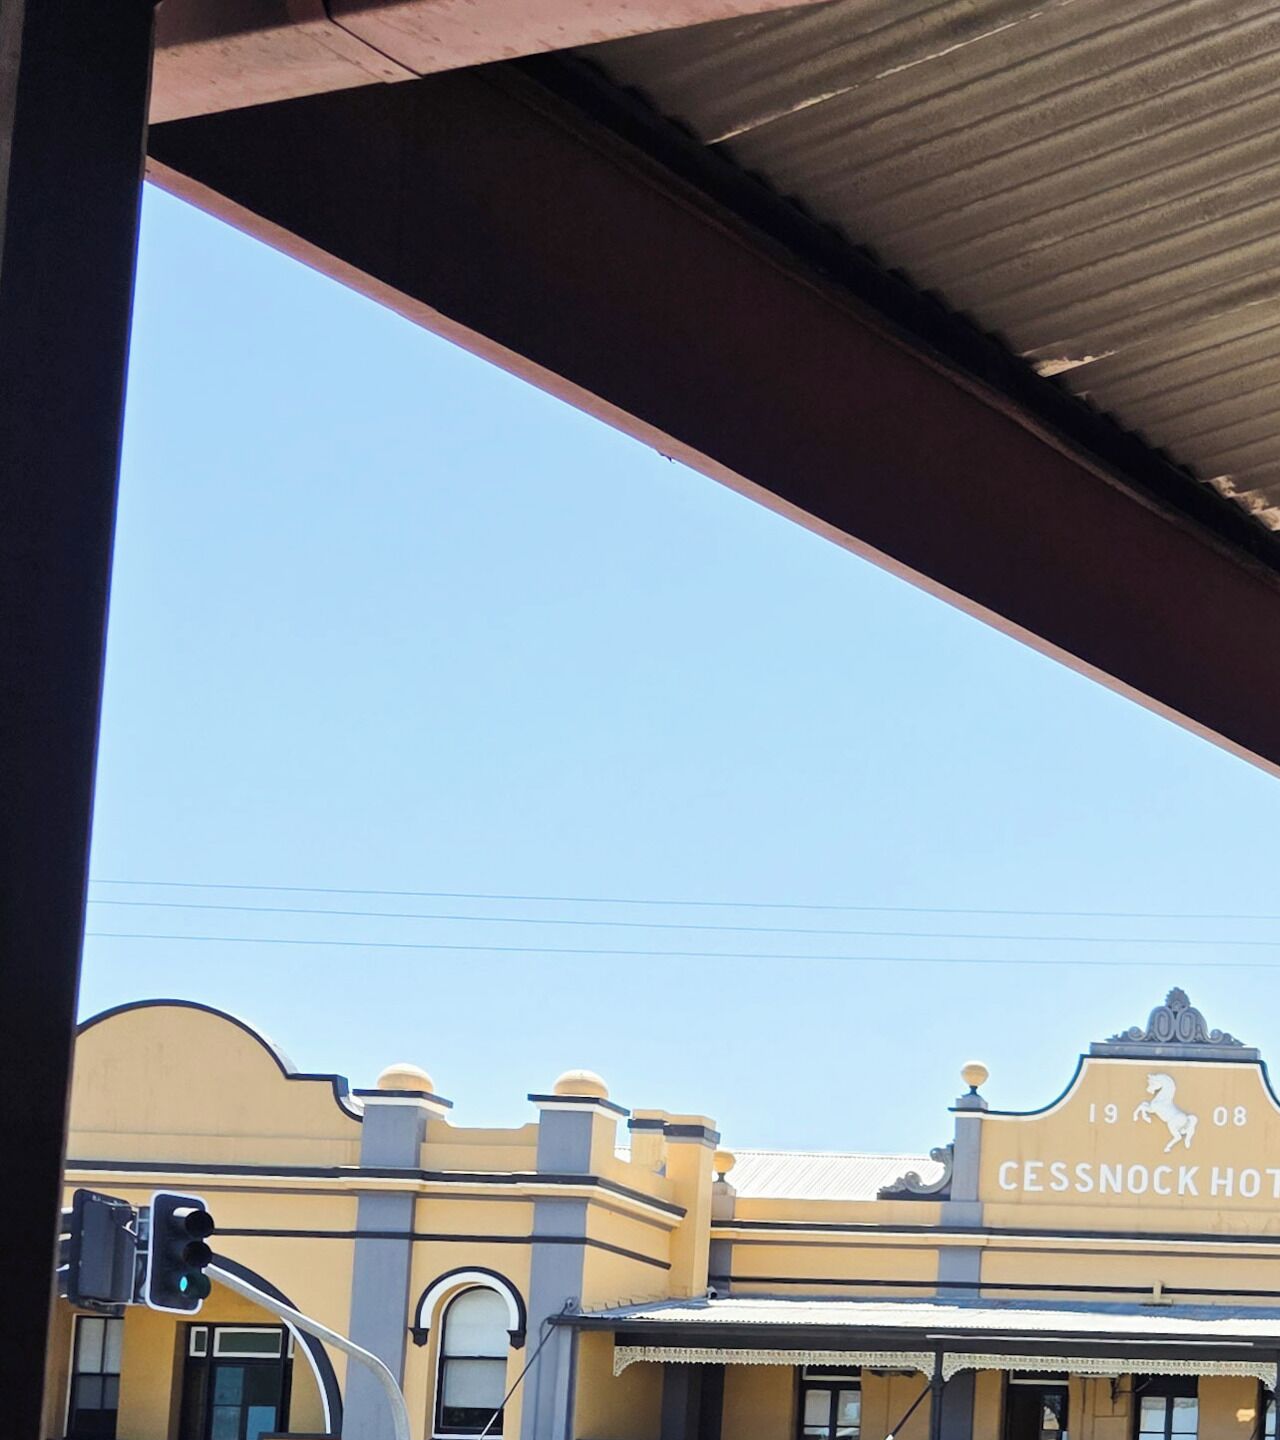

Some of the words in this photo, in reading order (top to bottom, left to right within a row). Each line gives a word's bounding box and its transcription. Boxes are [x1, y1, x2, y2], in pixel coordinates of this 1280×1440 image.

[1089, 1103, 1118, 1124] 19
[1213, 1106, 1247, 1127] 08
[998, 1161, 1199, 1196] CESSNOCK
